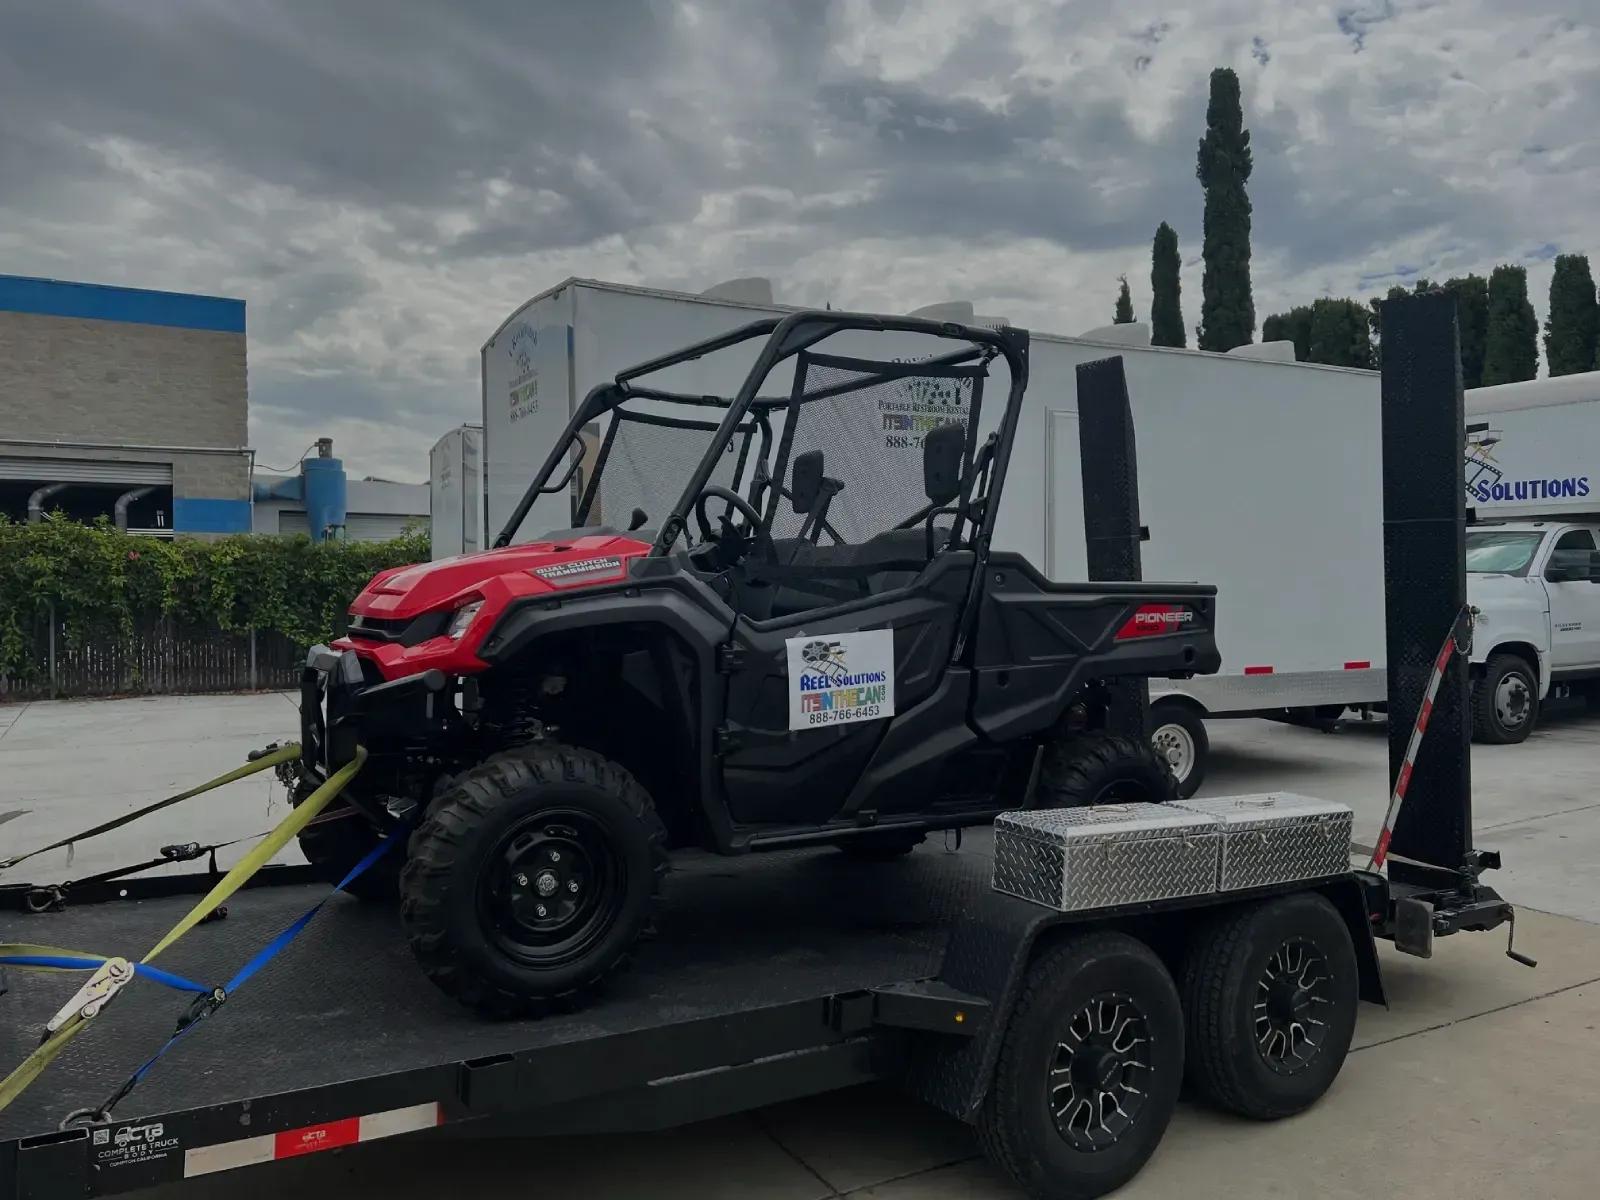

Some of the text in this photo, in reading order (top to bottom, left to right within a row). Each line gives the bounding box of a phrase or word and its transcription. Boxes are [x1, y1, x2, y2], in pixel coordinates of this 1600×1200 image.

[1477, 477, 1590, 502] SOLUTIONS
[535, 557, 608, 574] DUAL CLUTCH
[541, 560, 620, 578] TRANSMISSION
[1135, 611, 1193, 623] PIONEER
[800, 671, 886, 692] REEL SOLUTIONS
[809, 705, 880, 724] 888-766-6453
[98, 1138, 179, 1158] COMPLETE TRUCK
[124, 1149, 153, 1160] BODY
[137, 1153, 168, 1163] CALIFORNIA
